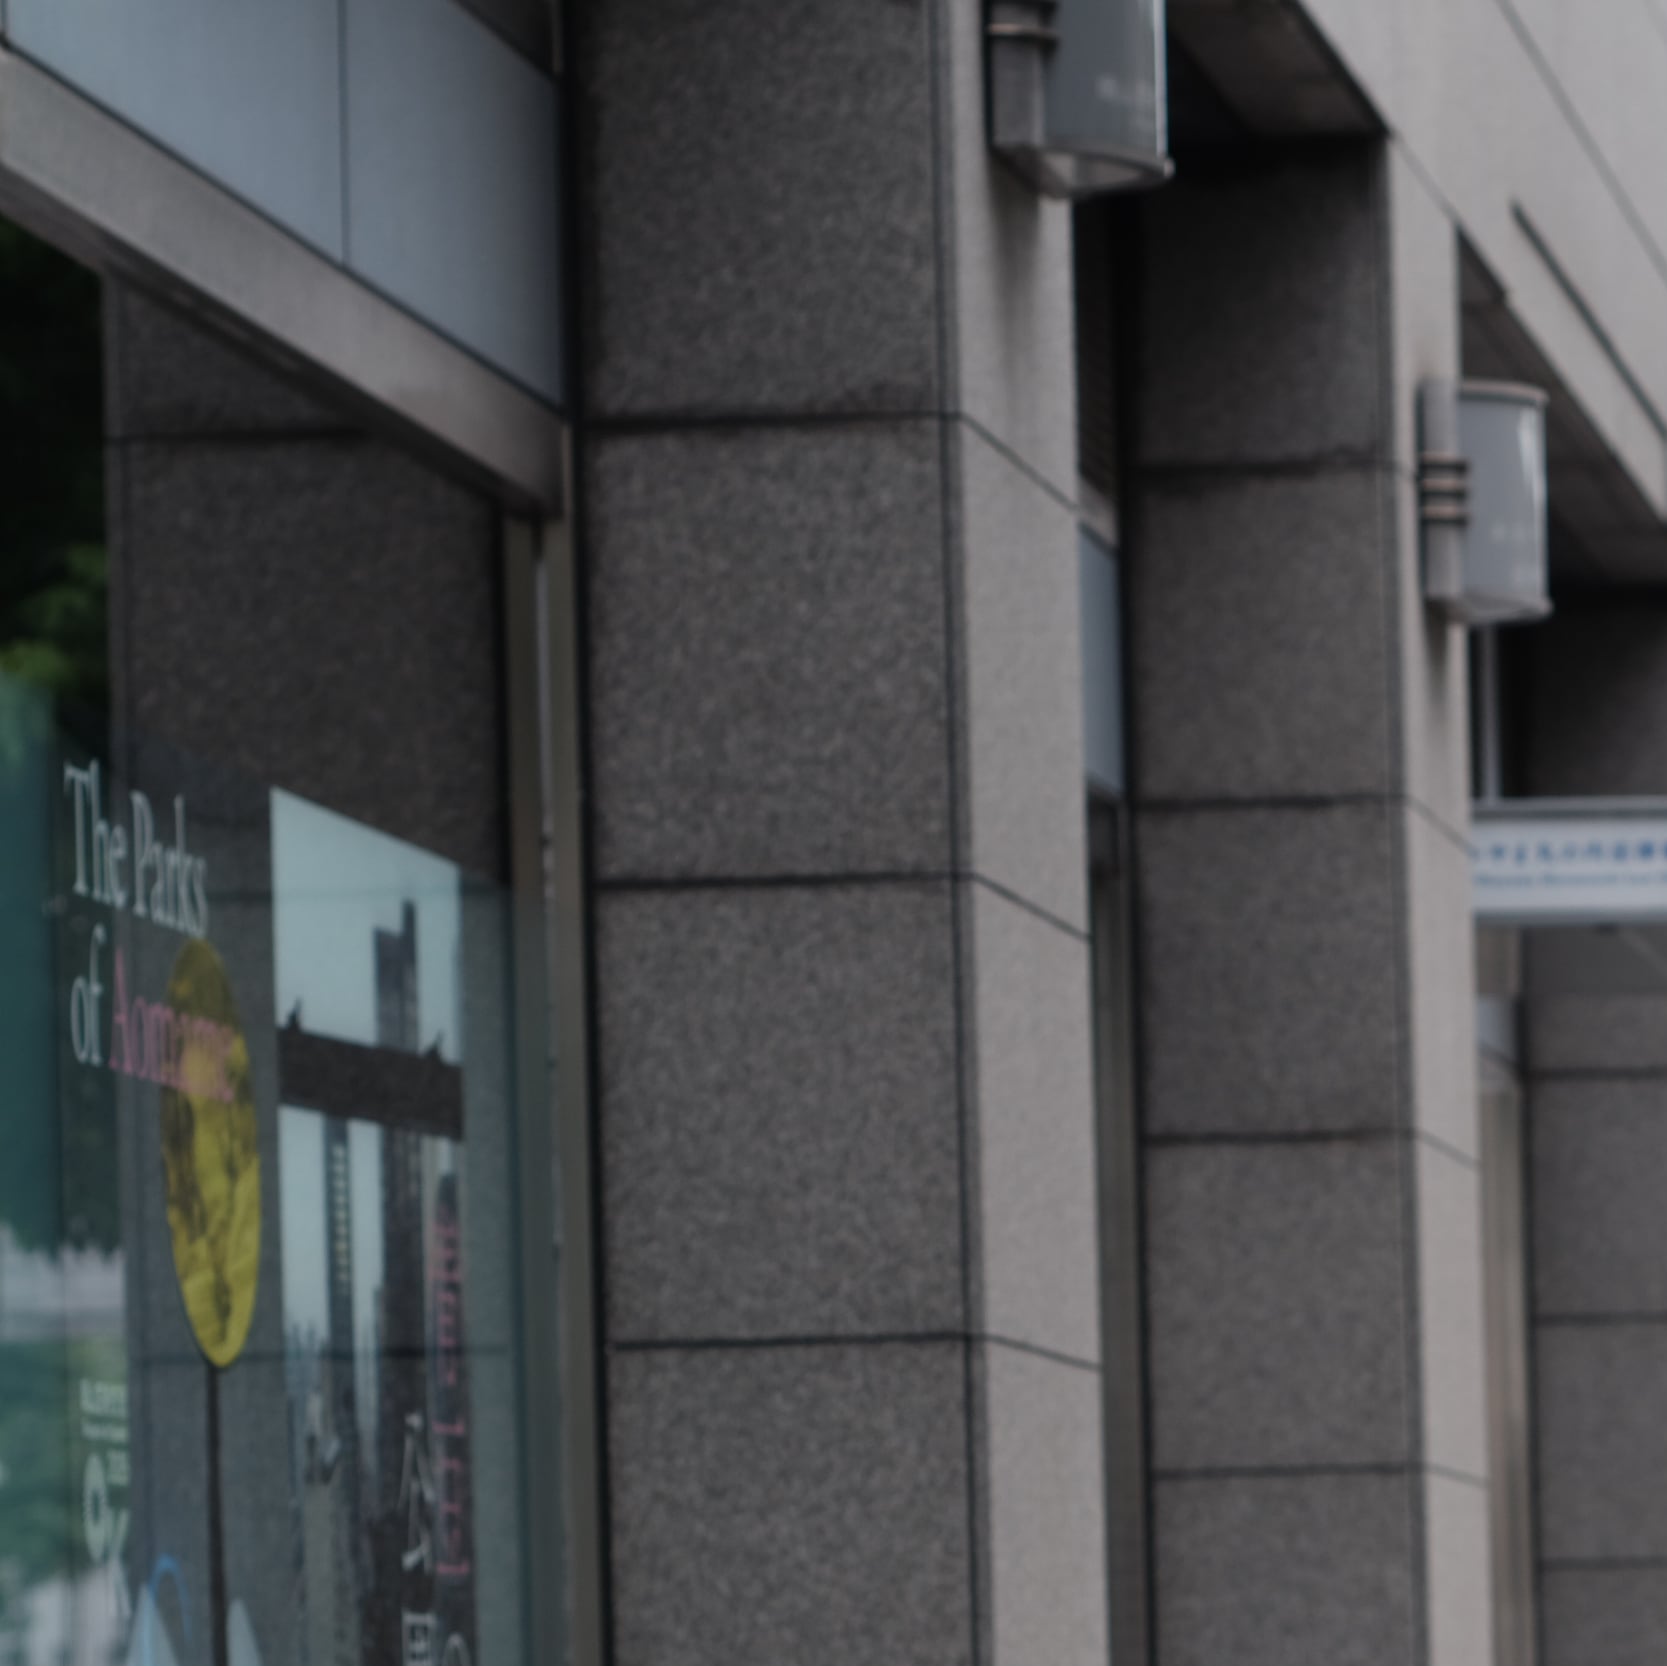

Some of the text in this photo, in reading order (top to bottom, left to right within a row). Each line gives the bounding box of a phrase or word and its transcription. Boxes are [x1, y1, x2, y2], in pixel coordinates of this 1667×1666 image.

[64, 759, 208, 937] The Parks
[71, 925, 106, 1064] of
